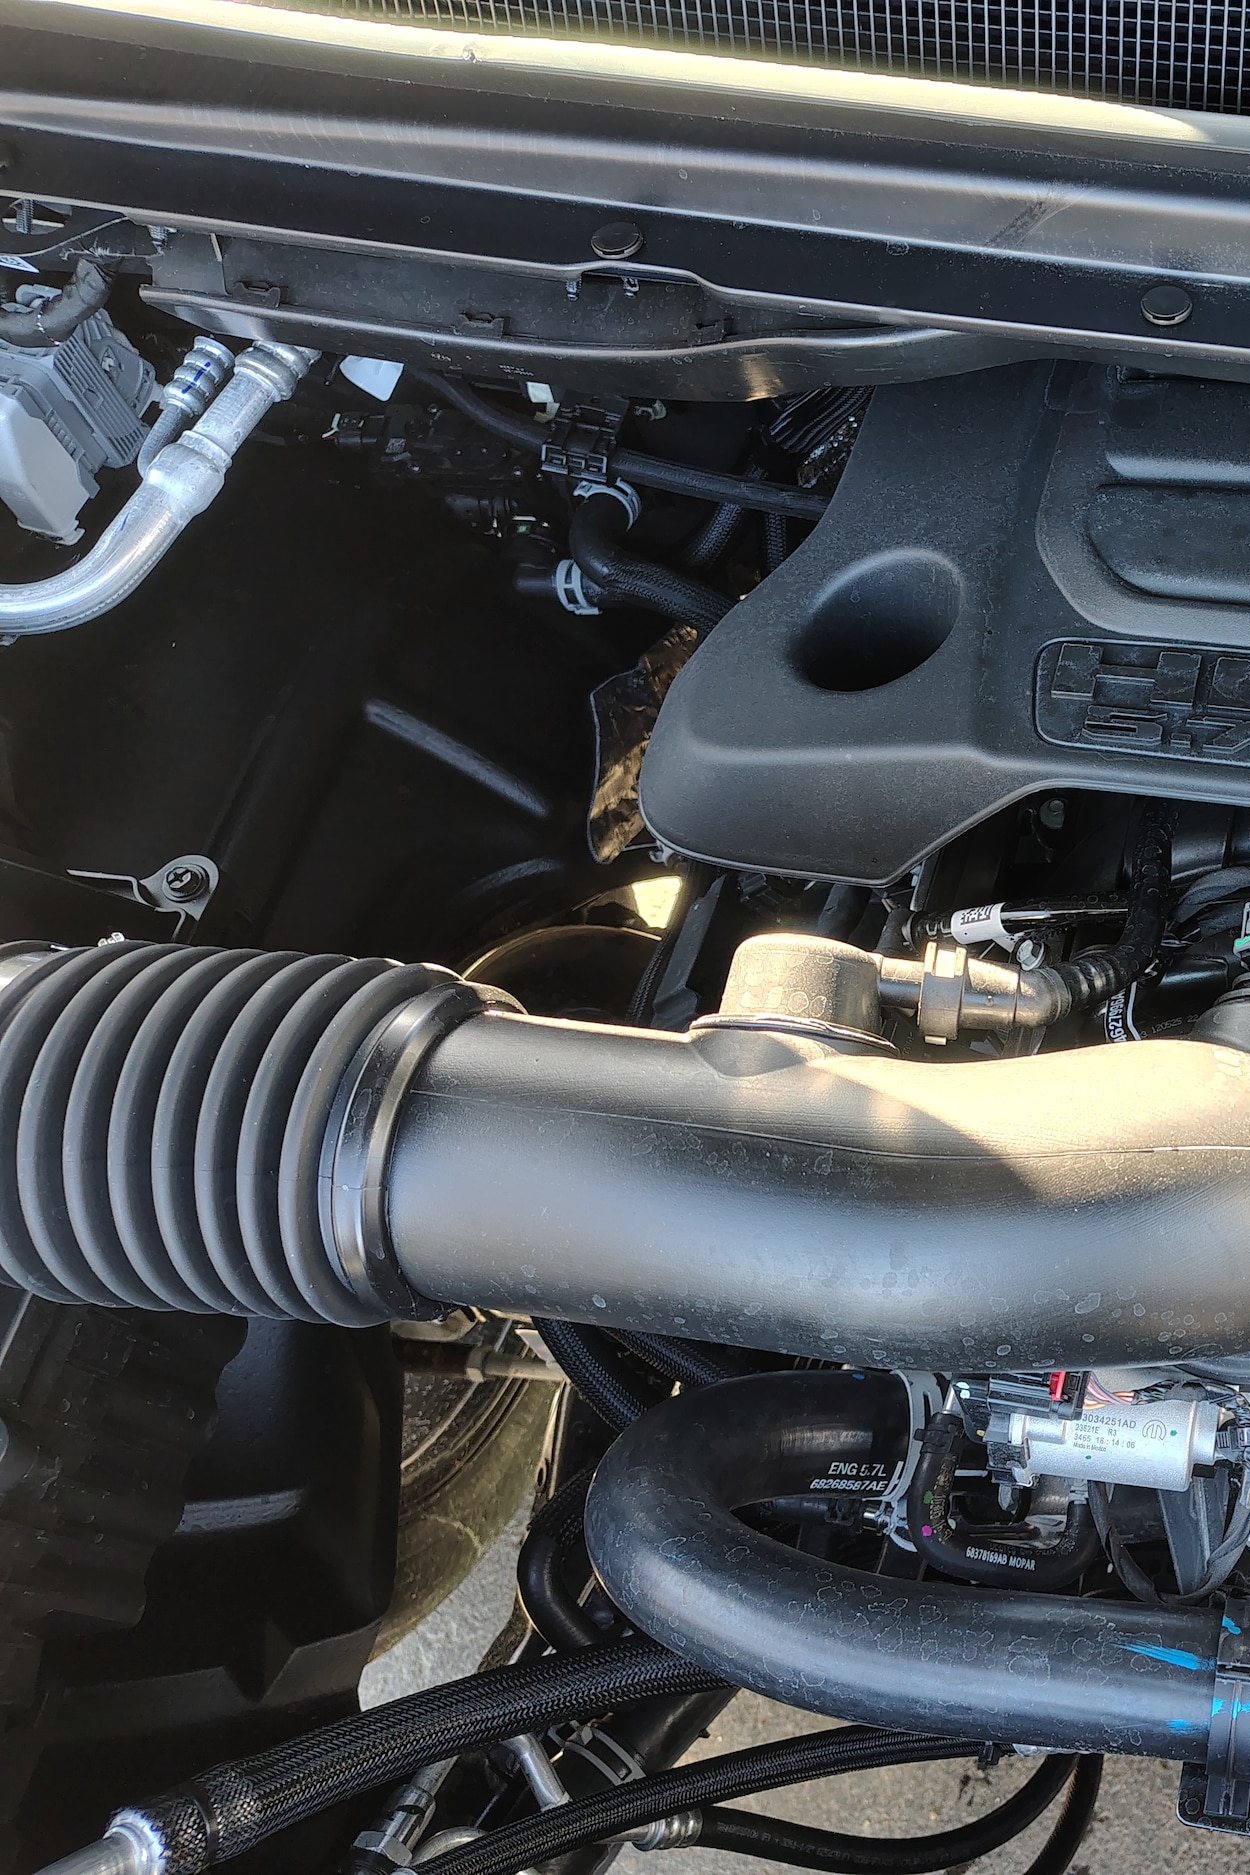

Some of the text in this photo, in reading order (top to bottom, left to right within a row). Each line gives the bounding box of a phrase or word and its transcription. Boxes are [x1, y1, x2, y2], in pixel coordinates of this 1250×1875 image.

[1108, 987, 1128, 1042] 4627996A
[828, 1461, 887, 1477] ENG 5.7L
[1009, 1556, 1036, 1571] MOPAR
